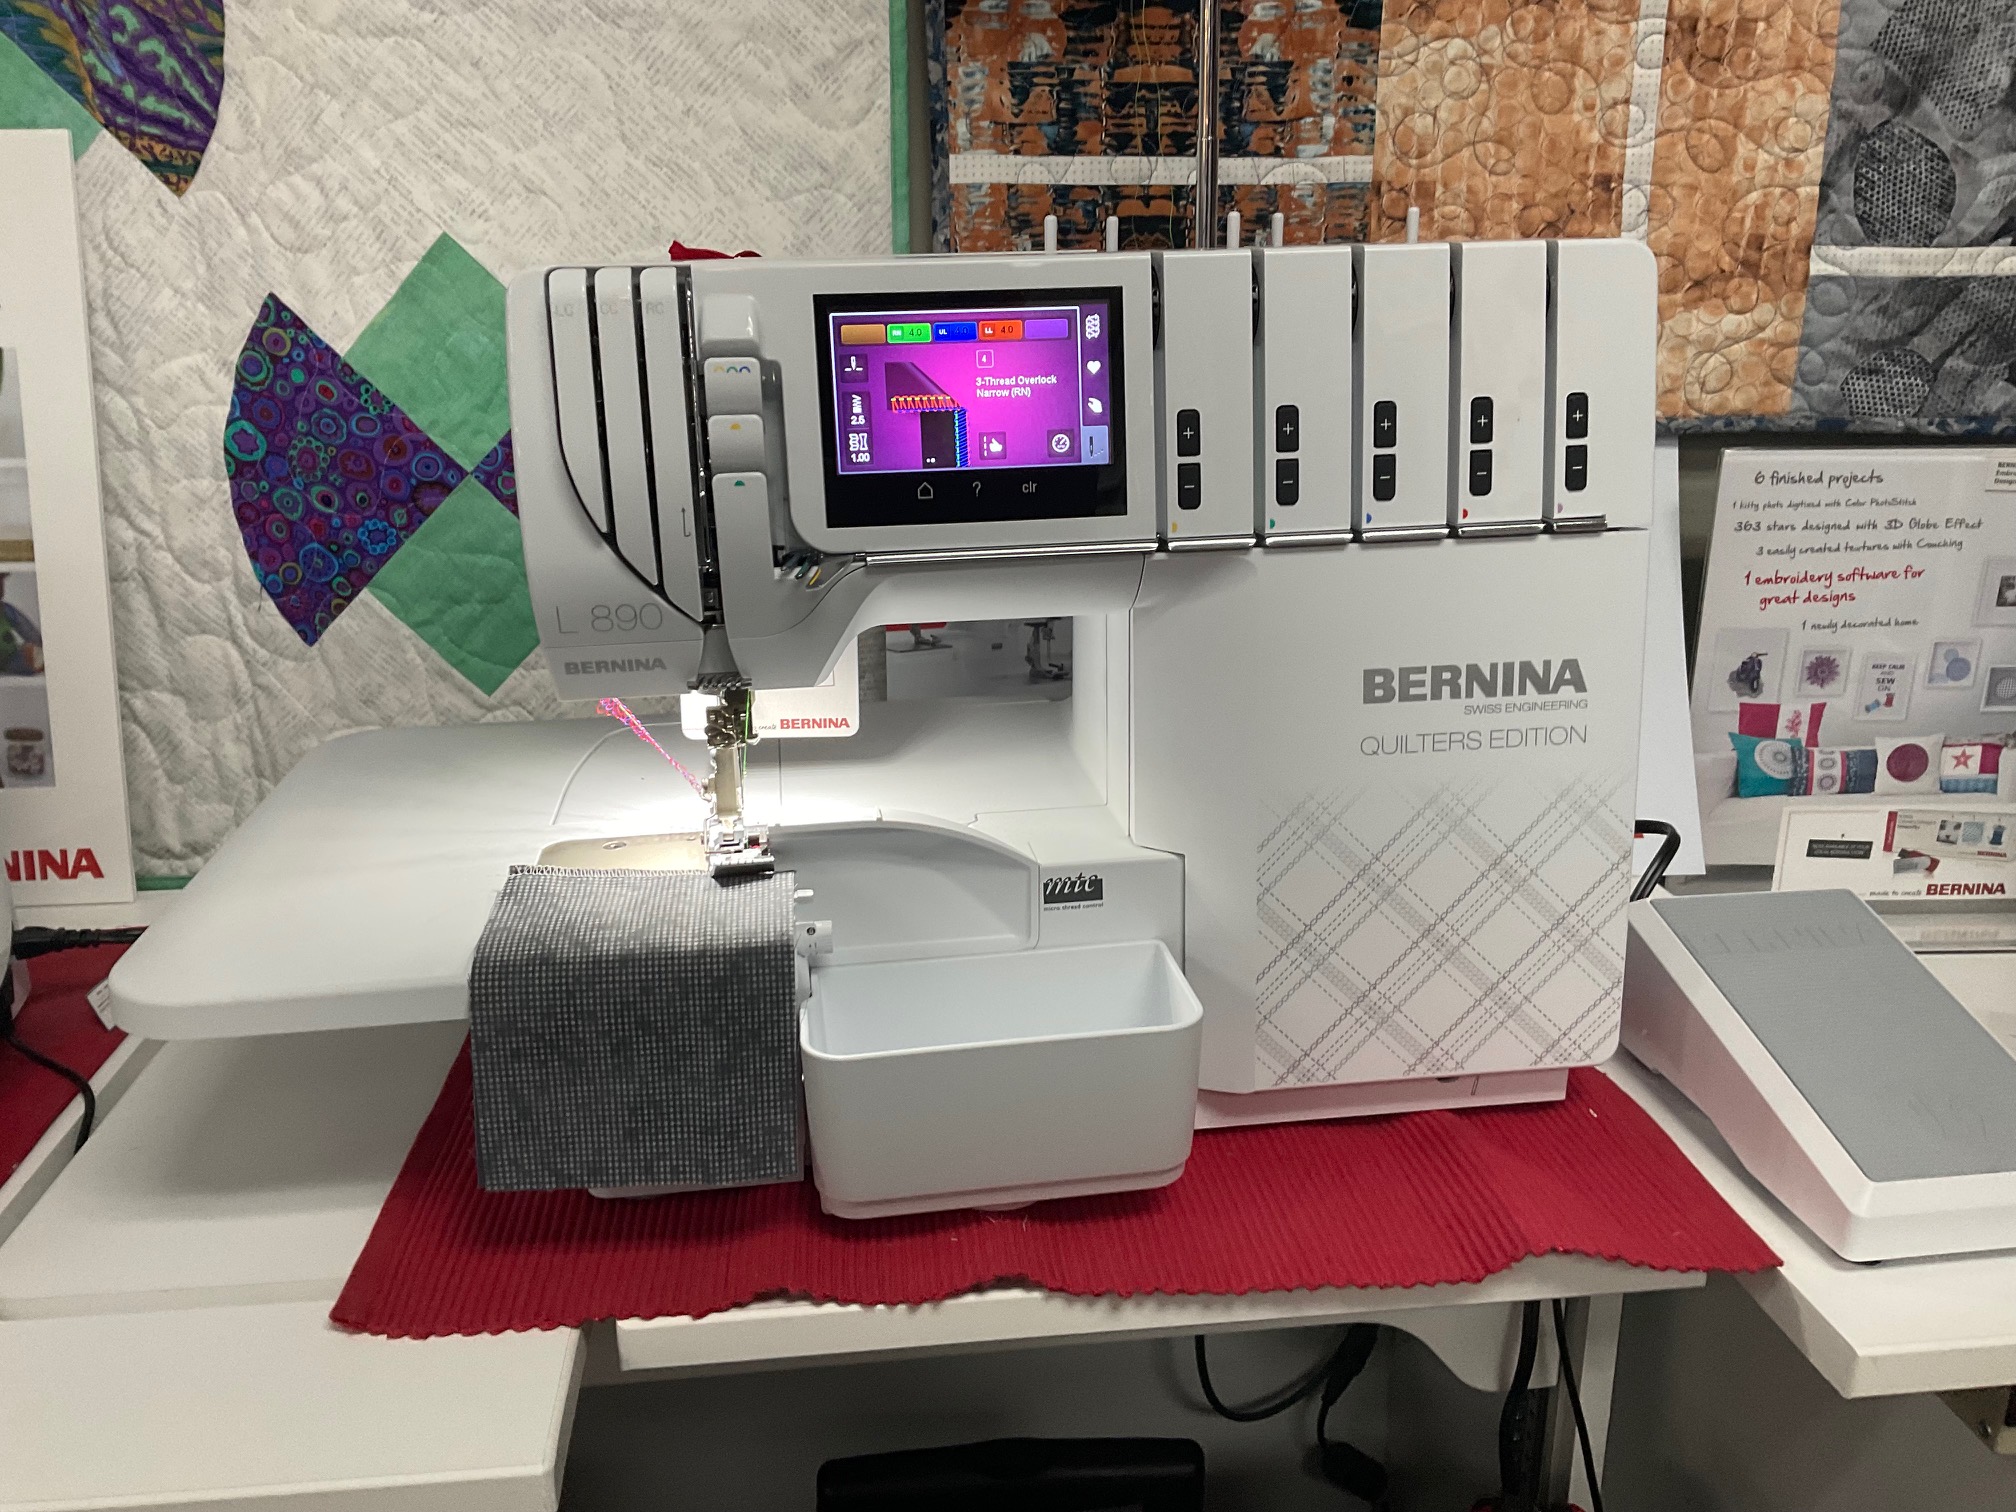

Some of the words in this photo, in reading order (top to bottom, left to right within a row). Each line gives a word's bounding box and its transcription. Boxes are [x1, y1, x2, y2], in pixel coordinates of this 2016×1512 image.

[975, 376, 1015, 387] 3-Thread
[1017, 373, 1058, 385] Overlock
[976, 387, 1010, 398] Narrow
[1011, 387, 1031, 398] (RN)
[850, 452, 870, 463] 1.00
[1022, 480, 1037, 494] clr
[1754, 471, 1765, 484] 6
[1770, 470, 1824, 485] finished
[1828, 469, 1884, 488] projects
[1825, 499, 1841, 507] with
[1845, 498, 1866, 507] Color
[1734, 520, 1761, 531] 363
[1767, 520, 1796, 531] stars
[1802, 519, 1850, 535] designed
[1856, 519, 1878, 530] with
[1884, 518, 1903, 530] 3D
[1909, 517, 1939, 530] Globe
[1945, 517, 1984, 530] Effect
[1756, 546, 1764, 555] 3
[1767, 544, 1796, 559] easily
[1799, 542, 1840, 554] created
[1844, 540, 1889, 552] textures
[1892, 539, 1912, 550] with
[1916, 537, 1963, 552] Couching
[1744, 571, 1751, 586] 1
[1755, 569, 1833, 589] embroidery
[1837, 566, 1900, 583] software
[1904, 564, 1925, 579] for
[1759, 589, 1800, 611] great
[1802, 590, 1856, 608] designs
[556, 605, 578, 634] L
[591, 602, 663, 632] 890
[1802, 619, 1807, 631] 1
[1811, 618, 1838, 634] newly
[1840, 616, 1891, 630] decorated
[1894, 618, 1919, 626] home
[564, 657, 667, 676] BERNINA
[1363, 658, 1587, 705] BERNINA
[1464, 703, 1502, 715] SWISS
[1505, 699, 1588, 714] ENGINEERING
[780, 717, 850, 730] BERNINA
[1360, 731, 1482, 756] QUILTERS
[1489, 724, 1587, 749] EDITION
[1926, 883, 2006, 896] BERNINA
[1043, 904, 1060, 912] micro
